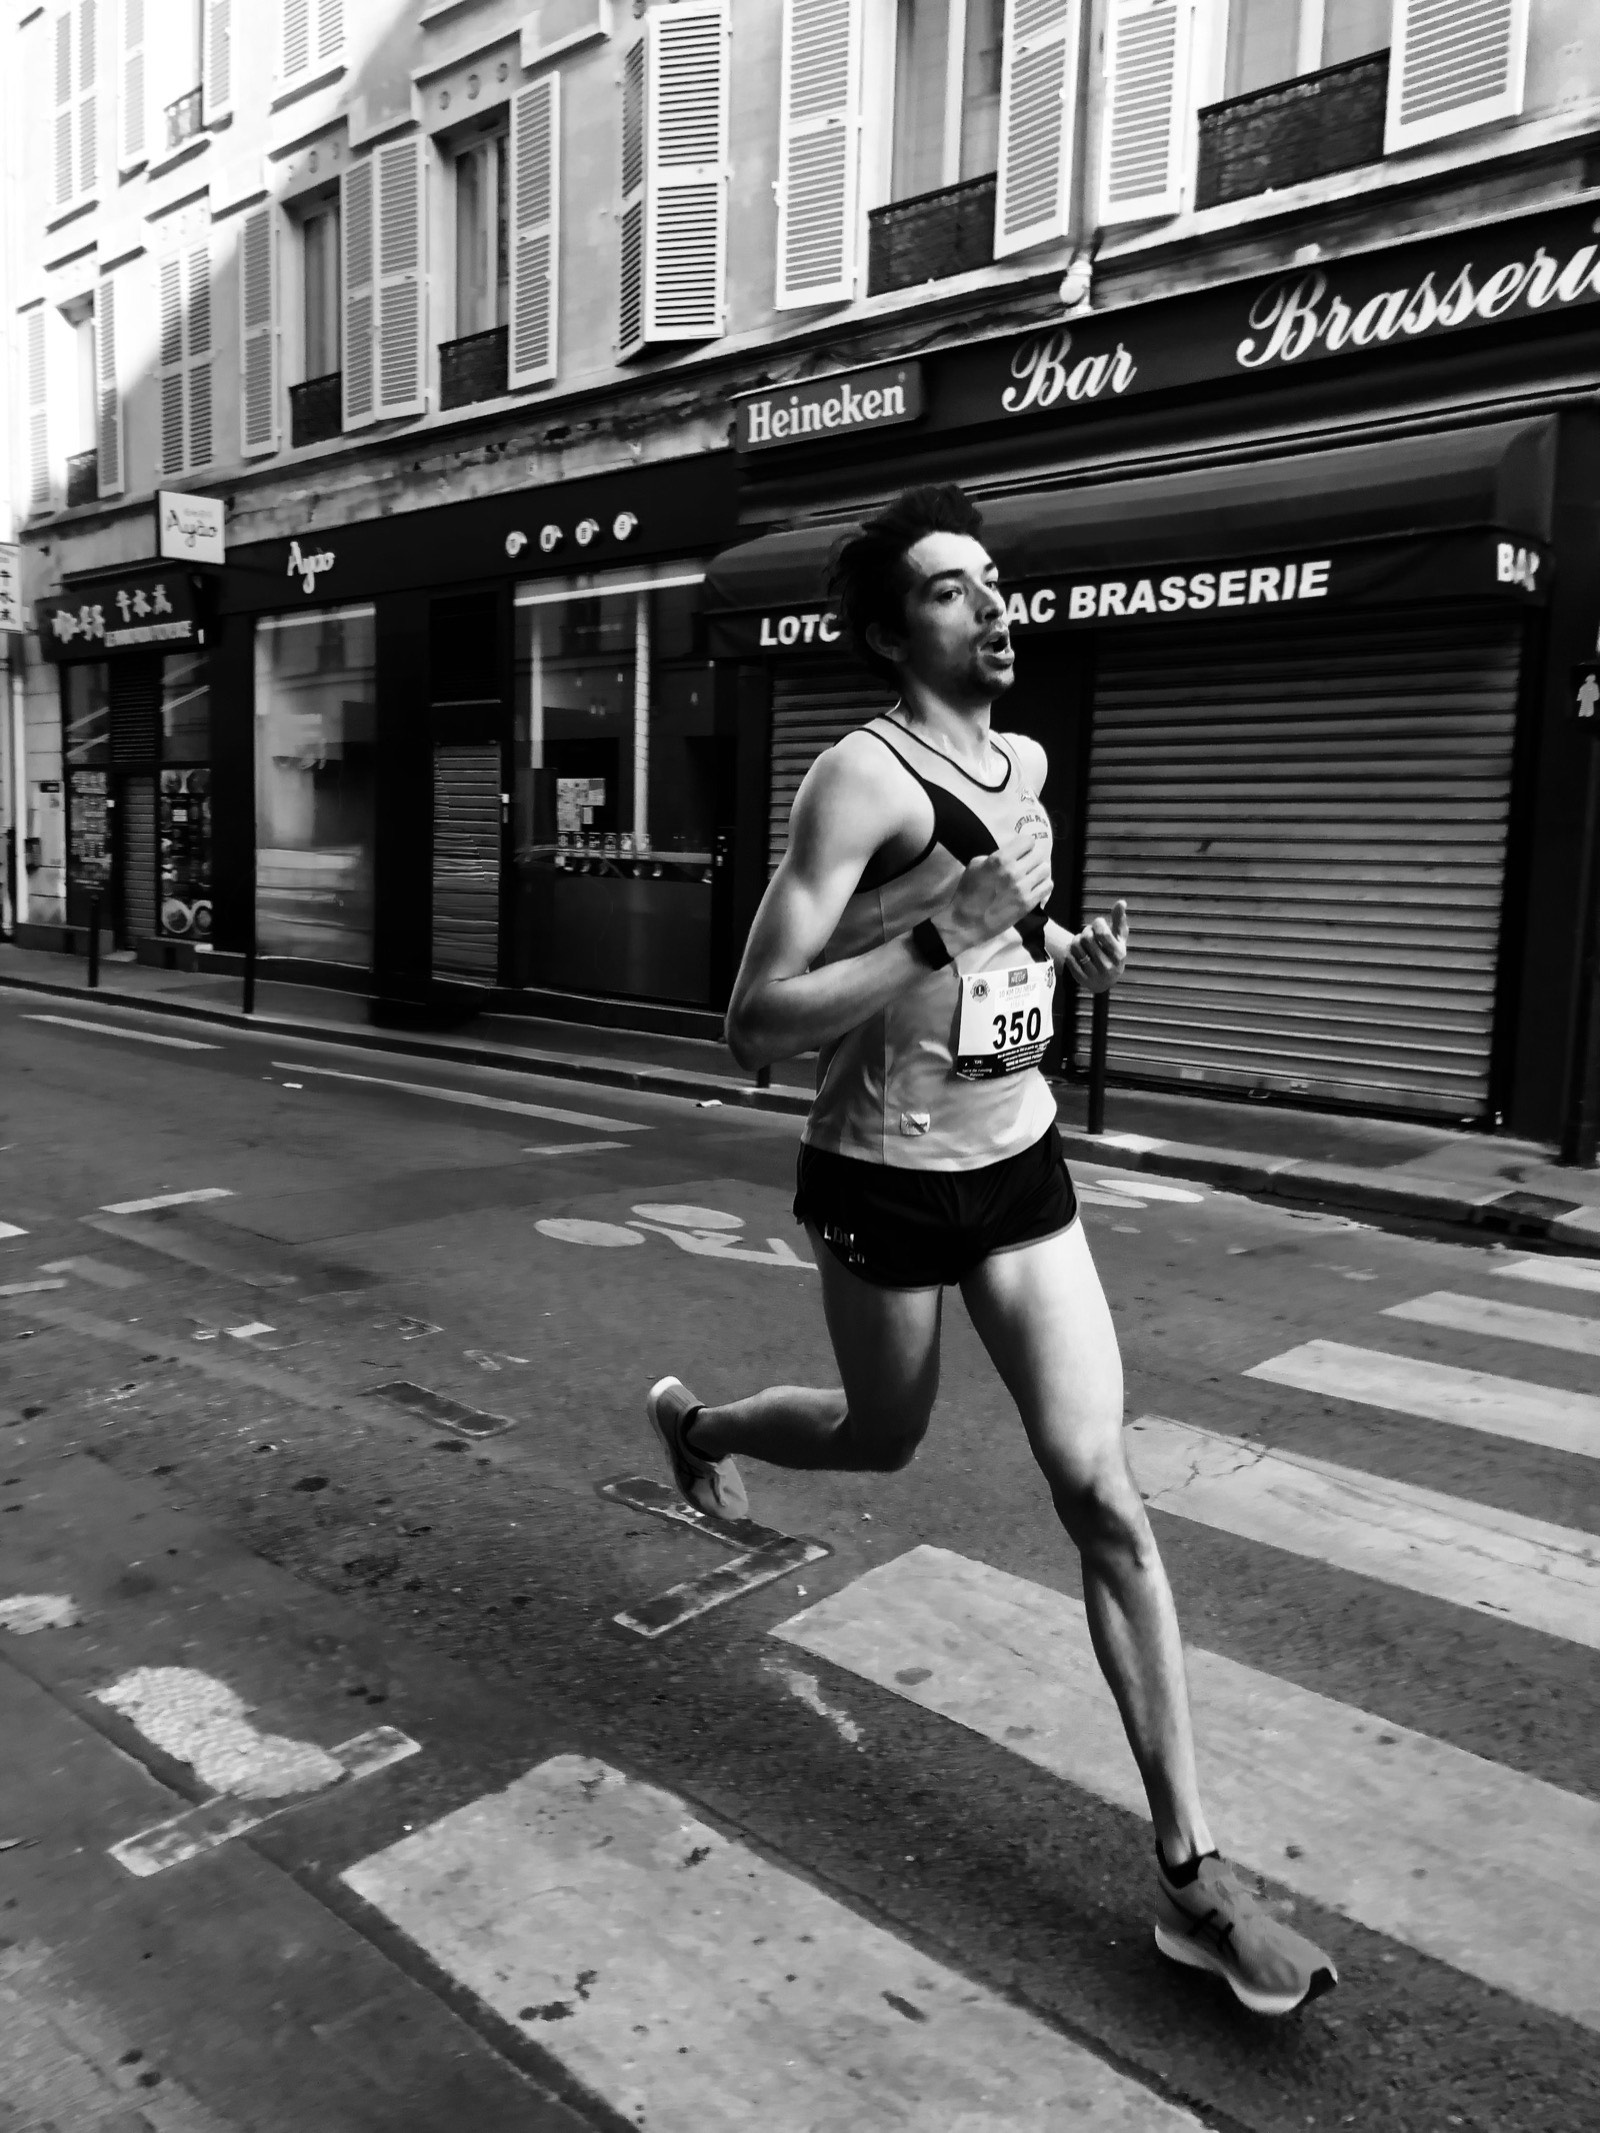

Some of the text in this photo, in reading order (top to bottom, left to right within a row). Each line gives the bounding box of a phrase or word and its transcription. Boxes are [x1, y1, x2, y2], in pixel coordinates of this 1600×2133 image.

[1236, 216, 1600, 367] Brasseri
[1002, 328, 1138, 412] Bar
[748, 384, 906, 443] Heineken
[1068, 560, 1331, 619] BRASSERIE
[992, 1007, 1041, 1050] 350
